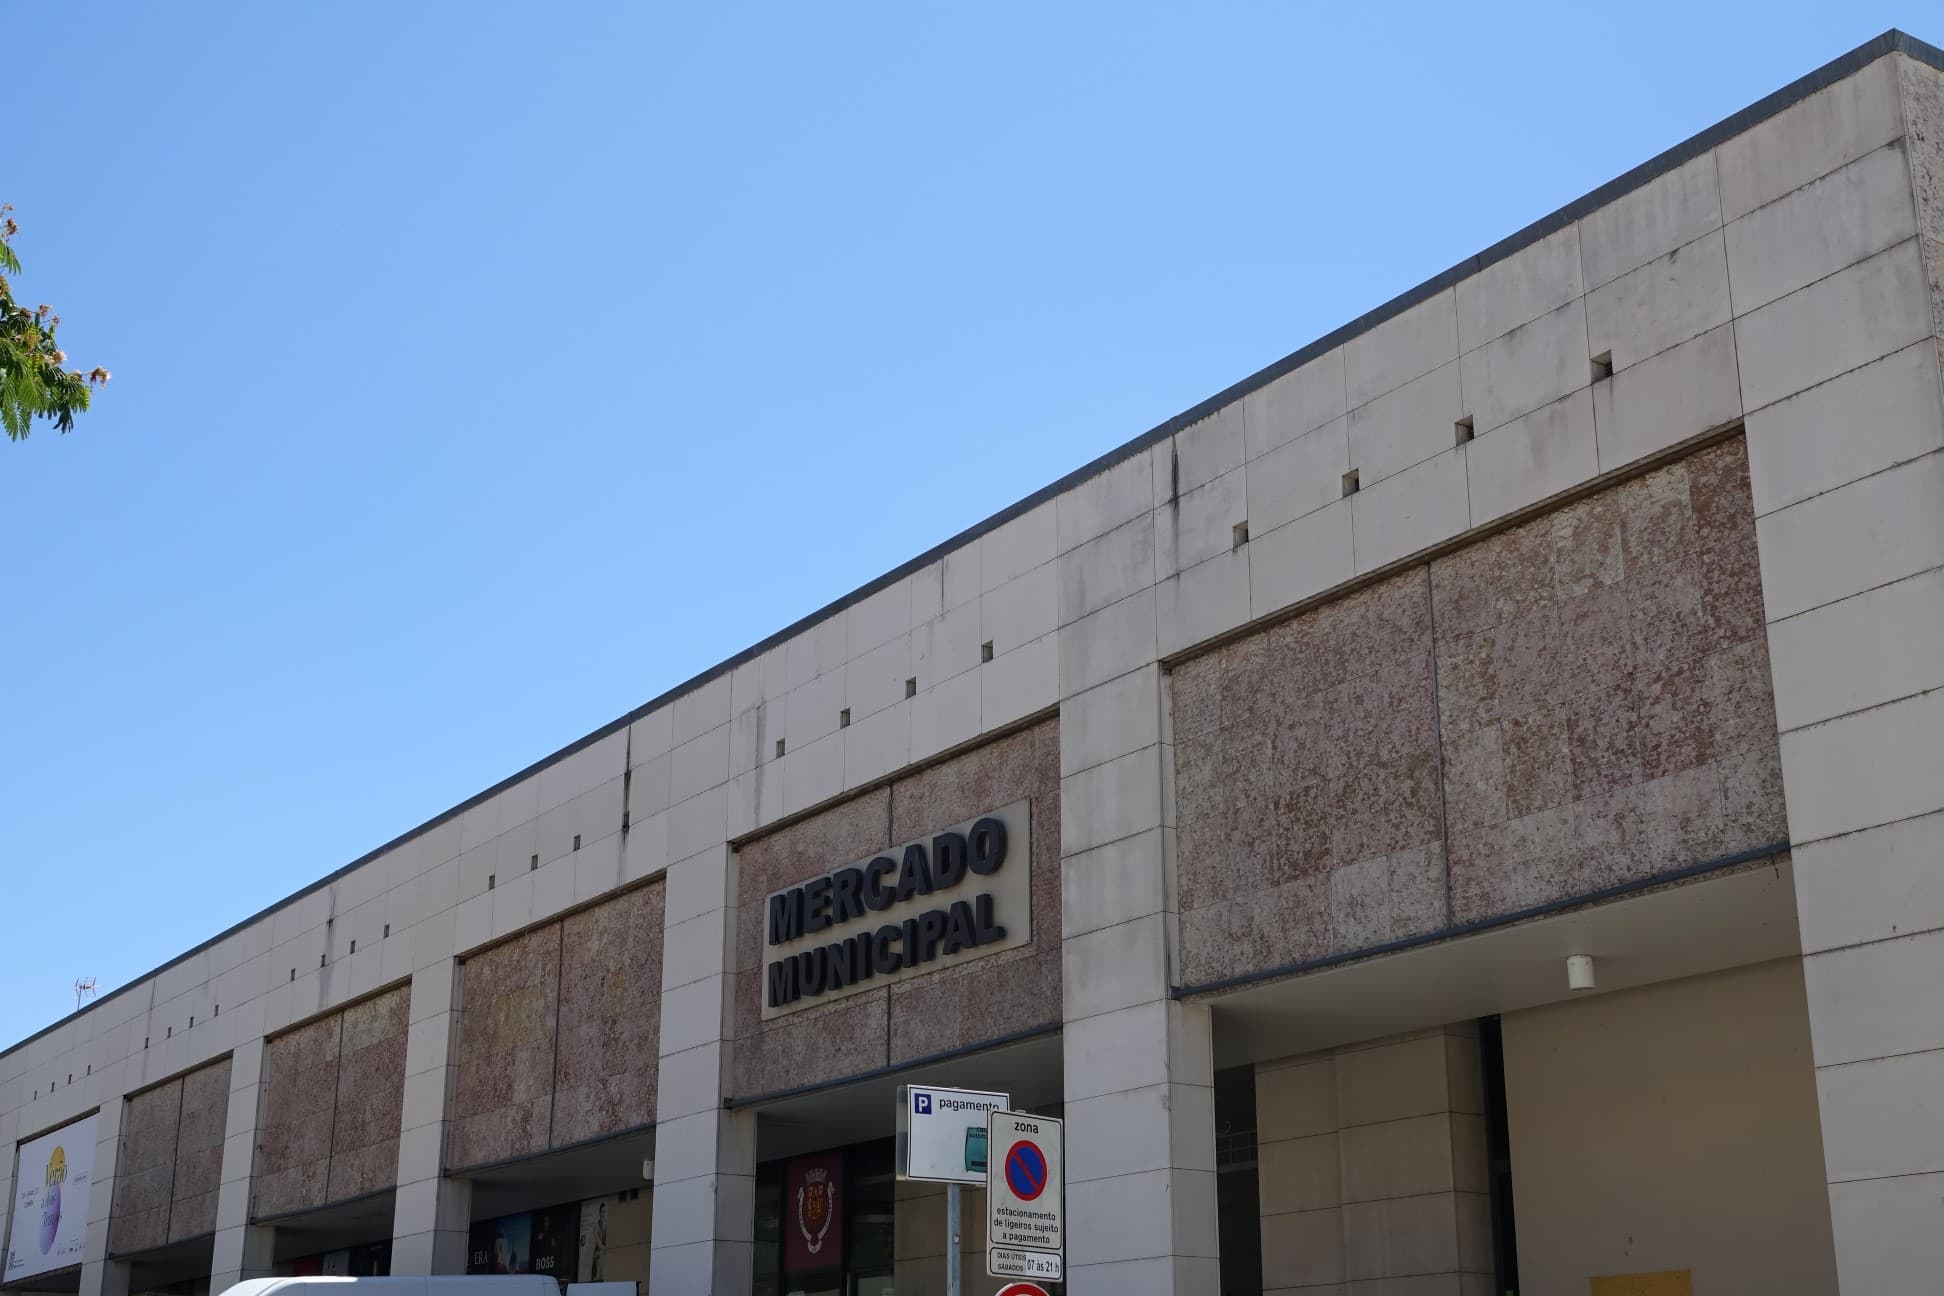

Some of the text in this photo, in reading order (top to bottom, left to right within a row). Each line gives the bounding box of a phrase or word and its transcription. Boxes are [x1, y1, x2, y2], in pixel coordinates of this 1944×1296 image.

[768, 817, 1007, 946] MERCADO
[768, 893, 1007, 1008] MUNICIPAL
[918, 1097, 1000, 1112] P pagamento
[1014, 1121, 1039, 1134] zona
[996, 1207, 1056, 1221] estacionamento
[993, 1218, 1059, 1234] de ligeiros sujeito
[1002, 1232, 1050, 1244] a pagamento
[535, 1255, 555, 1271] BOSS
[1027, 1259, 1035, 1270] 07
[1045, 1262, 1053, 1273] 21
